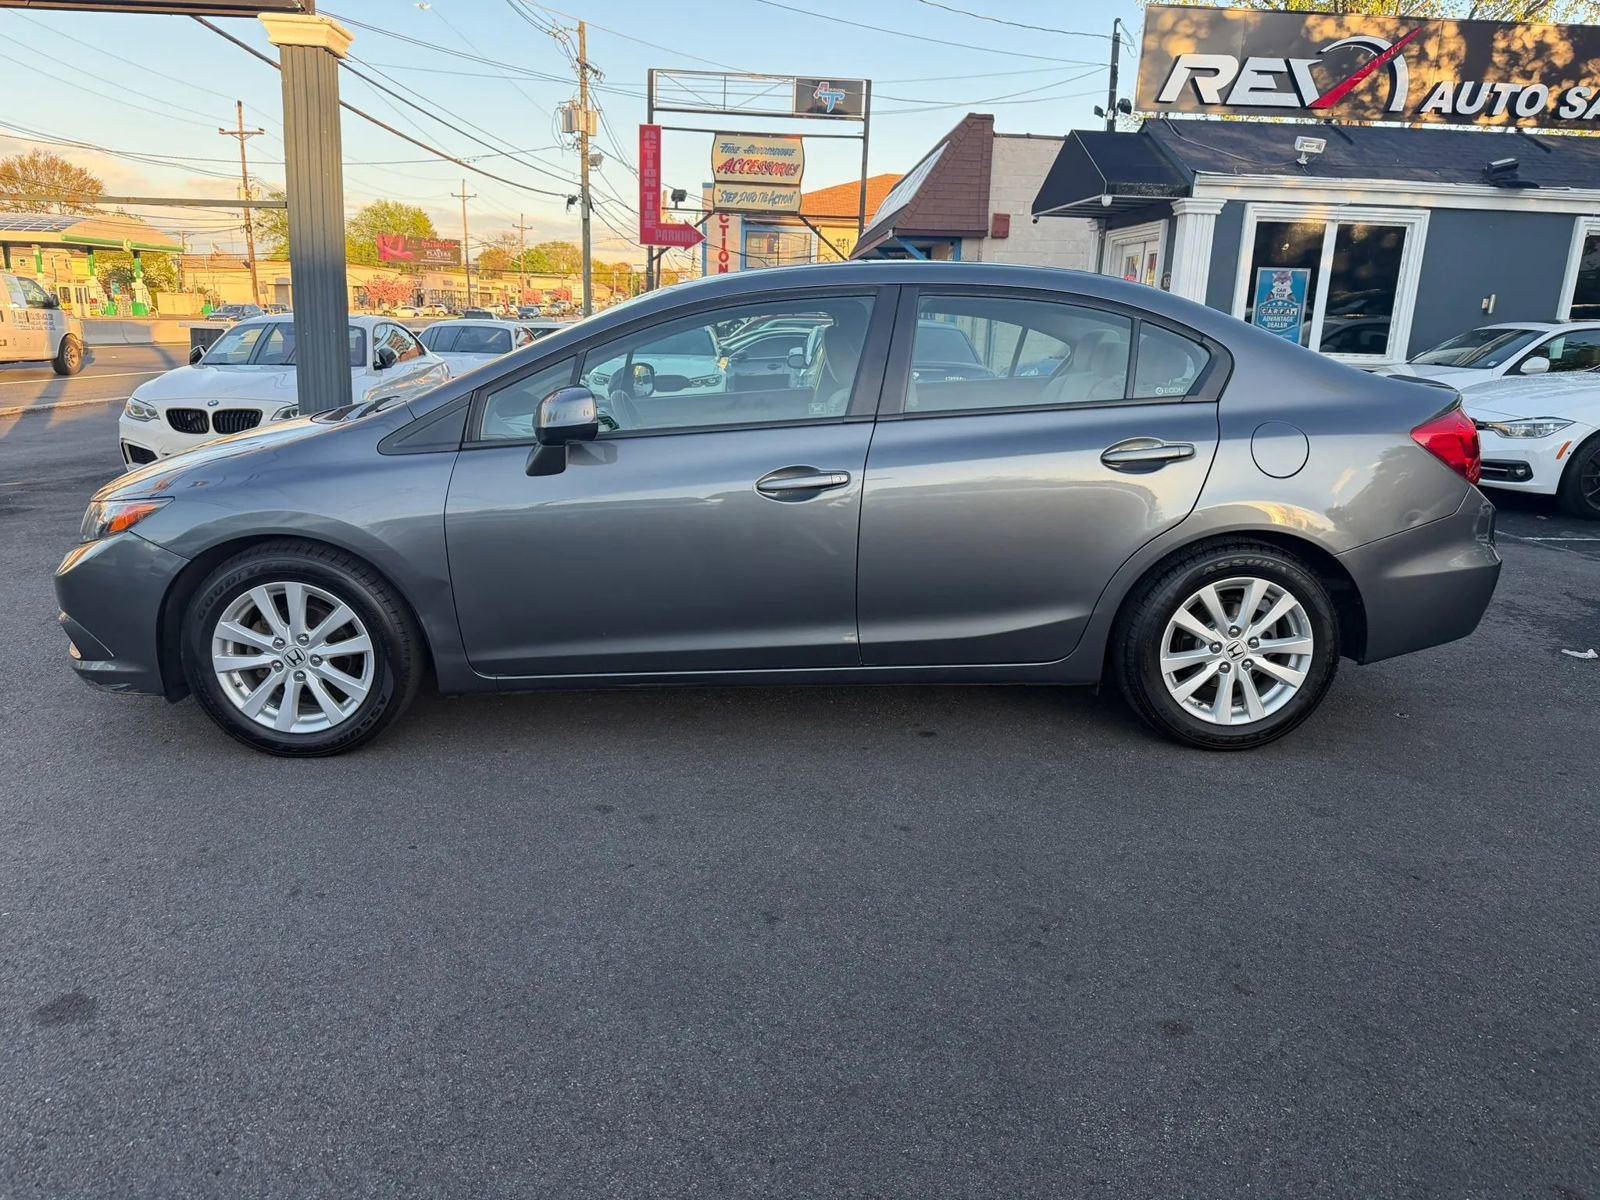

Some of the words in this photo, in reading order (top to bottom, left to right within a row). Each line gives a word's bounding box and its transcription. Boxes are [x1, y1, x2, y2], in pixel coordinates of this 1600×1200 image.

[1420, 81, 1549, 117] AUTO
[643, 131, 657, 188] ACTION
[717, 157, 800, 176] ACCESSORIES
[656, 228, 698, 243] PARKING
[1261, 306, 1298, 315] CARFAX
